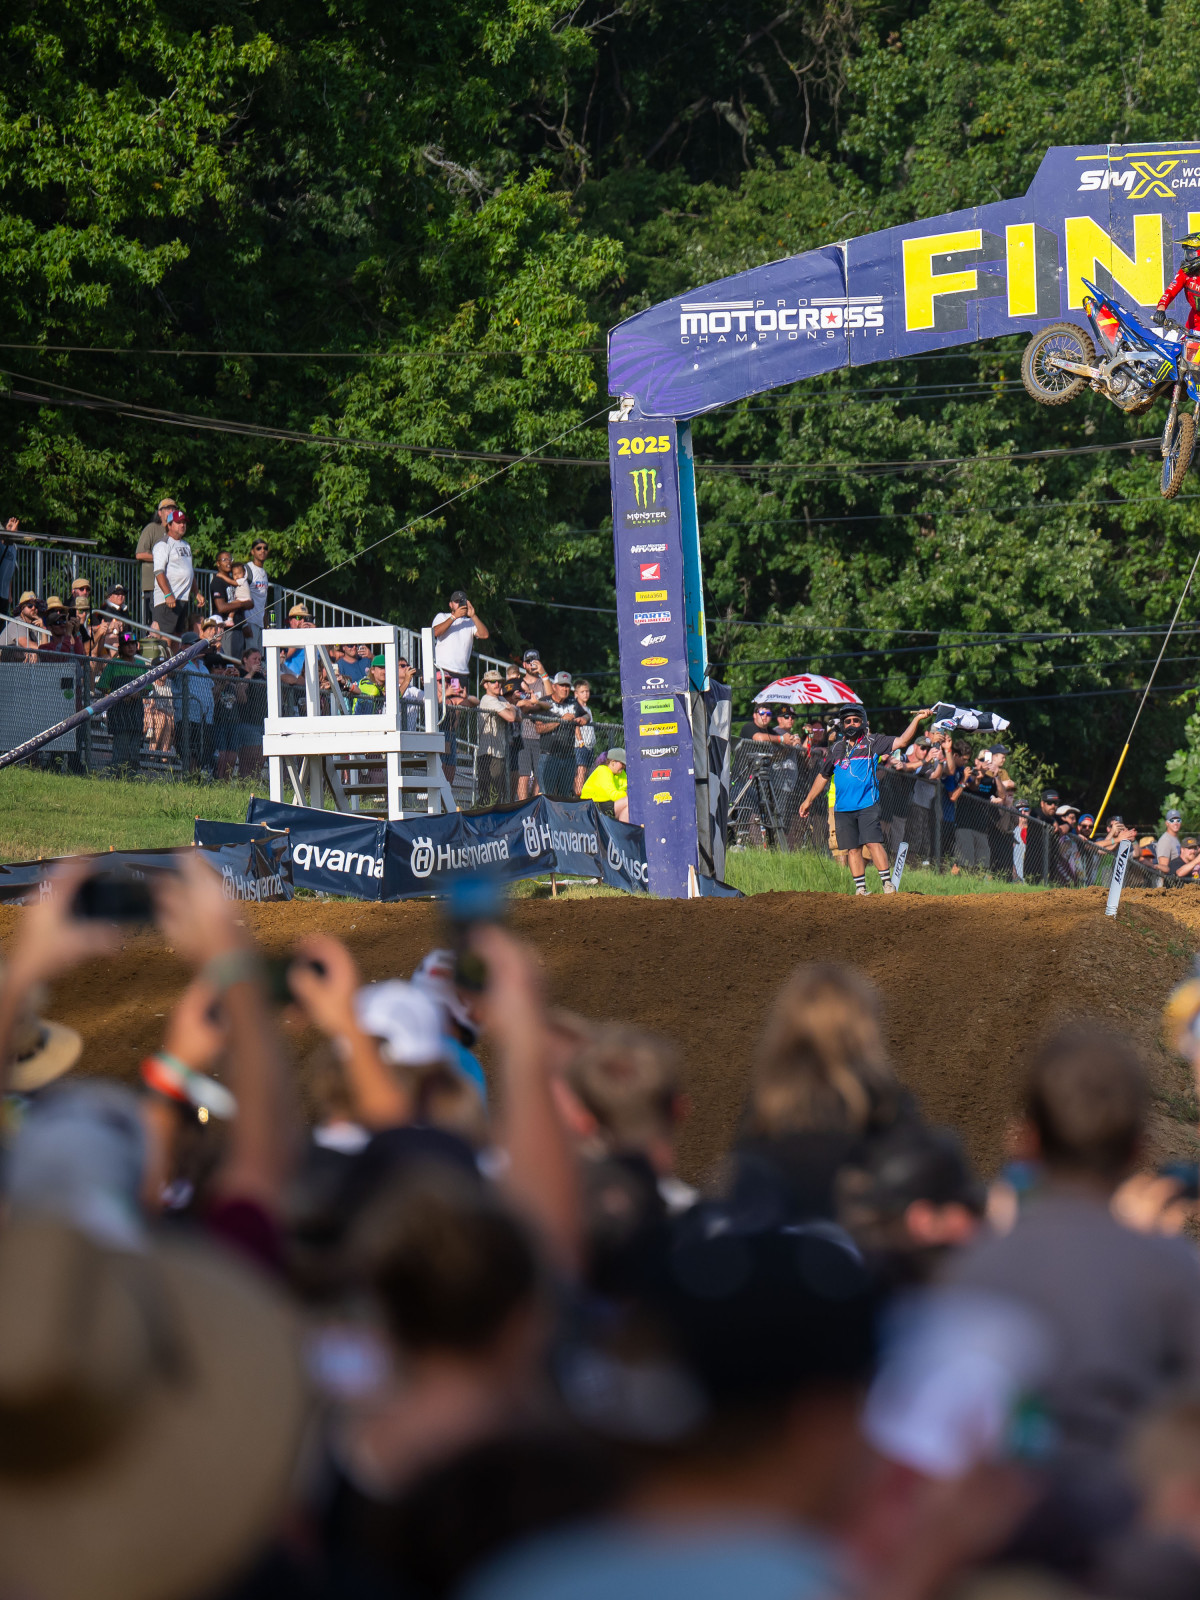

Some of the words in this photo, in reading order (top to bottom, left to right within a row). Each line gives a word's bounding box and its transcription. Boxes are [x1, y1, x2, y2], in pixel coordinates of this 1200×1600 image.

[756, 298, 808, 308] PRO
[680, 305, 884, 335] MOTOCROSS
[680, 328, 885, 345] CHAMPIONSHIP
[616, 435, 671, 456] 2025
[626, 511, 667, 521] MONSTER
[634, 611, 670, 620] PARTS
[644, 702, 671, 710] Kawasaki
[641, 746, 671, 757] TRIUMPH
[541, 822, 599, 856] Husqvarna
[437, 834, 508, 871] Husqvarna
